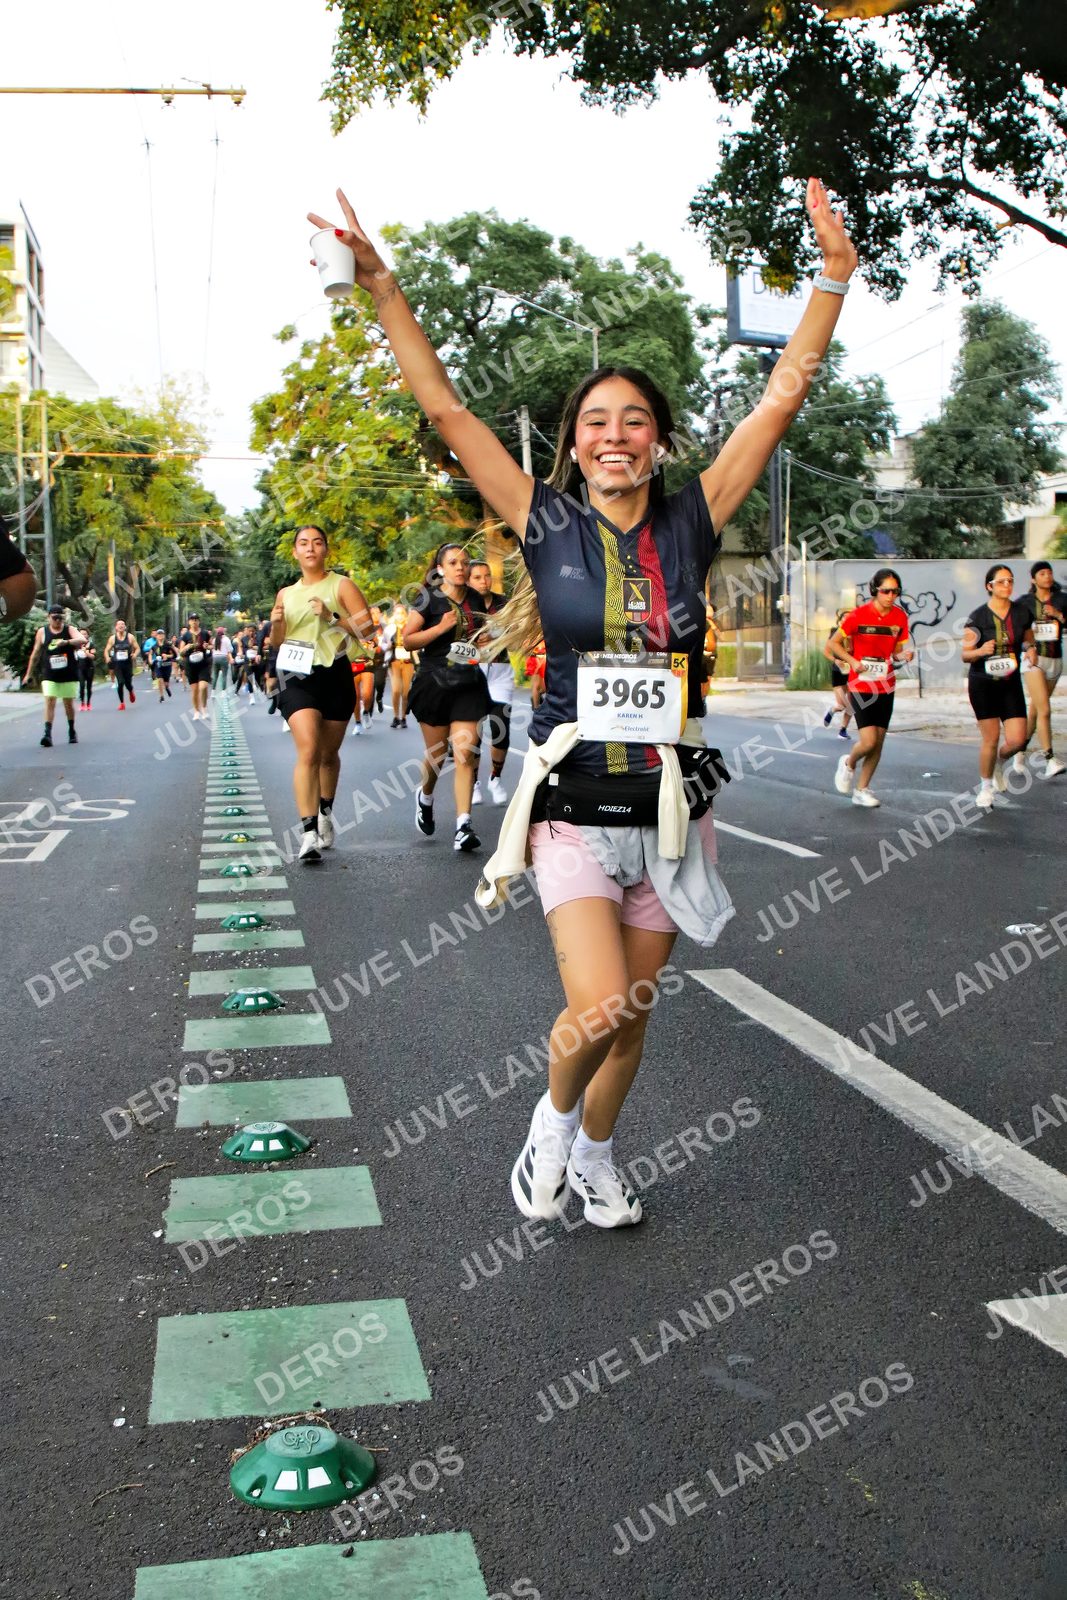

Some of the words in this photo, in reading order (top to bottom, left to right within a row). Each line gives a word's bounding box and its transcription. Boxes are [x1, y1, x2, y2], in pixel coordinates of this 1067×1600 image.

[288, 649, 304, 660] 777
[455, 645, 476, 657] 2290
[673, 657, 685, 668] 5K
[990, 662, 1010, 671] 6835
[593, 678, 666, 709] 3965
[598, 805, 632, 814] HDIEZ14
